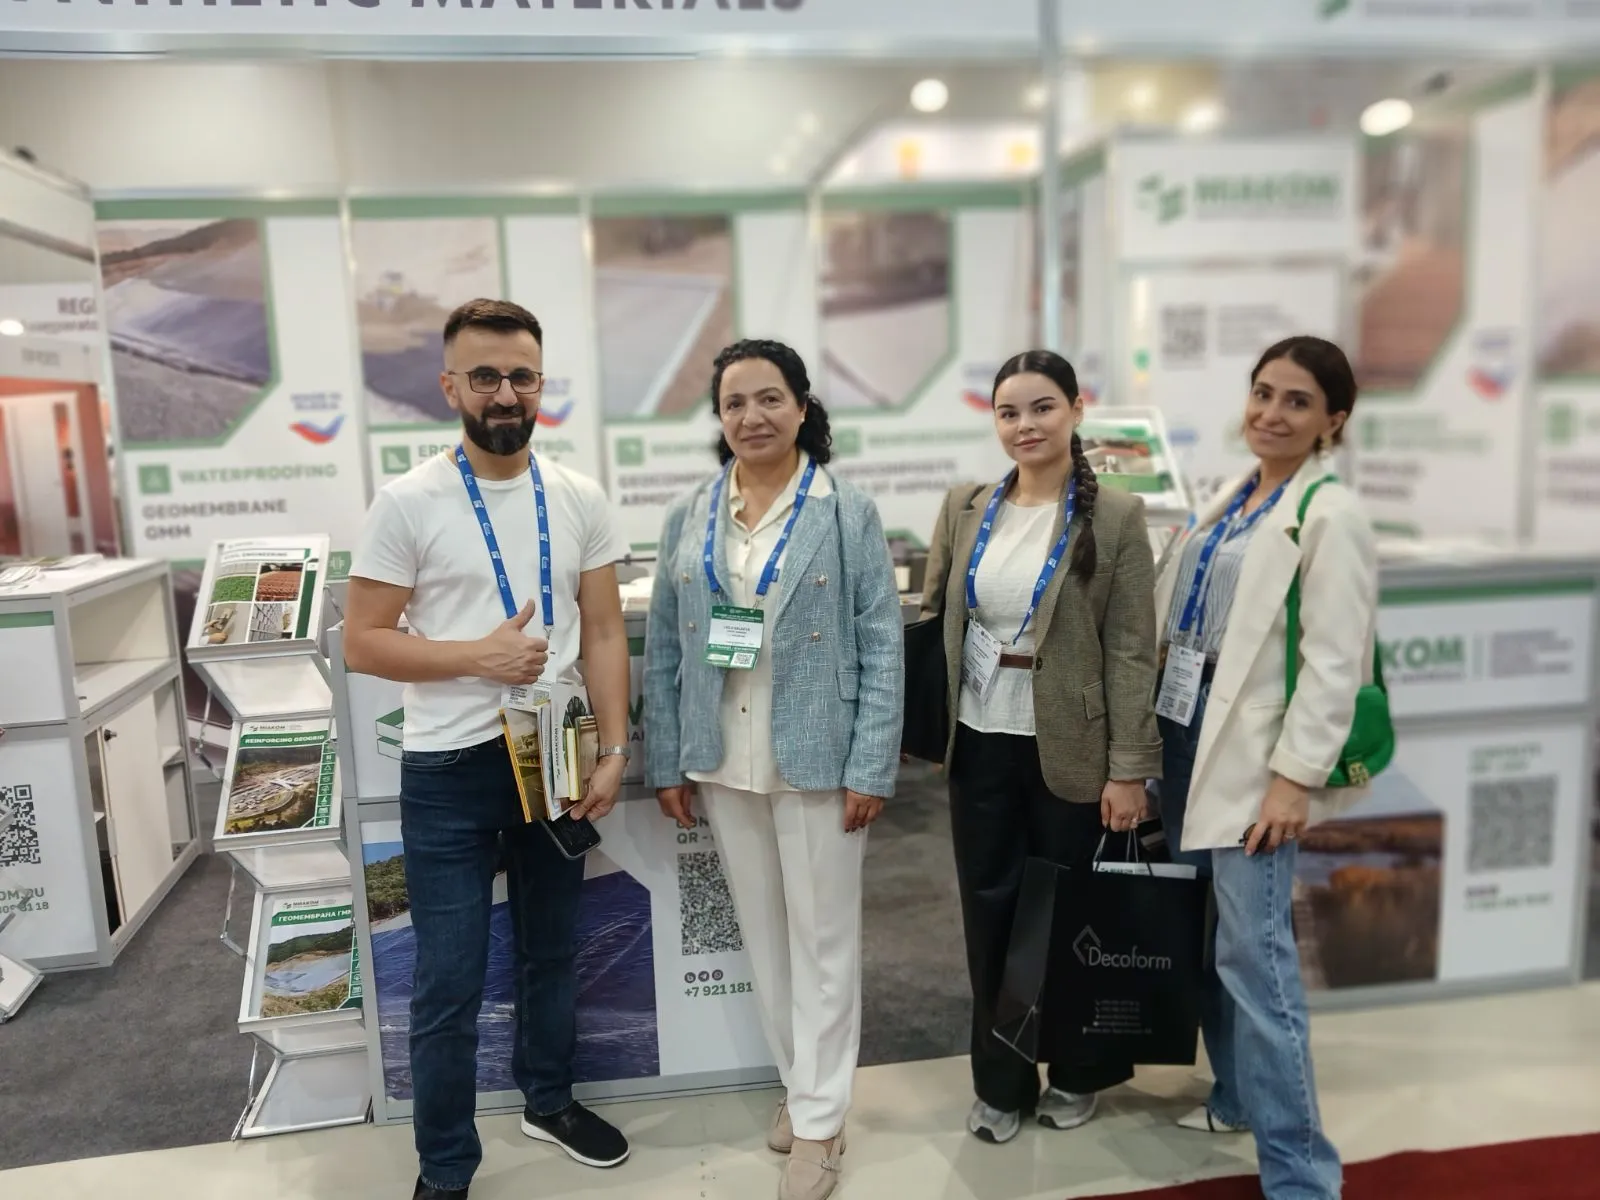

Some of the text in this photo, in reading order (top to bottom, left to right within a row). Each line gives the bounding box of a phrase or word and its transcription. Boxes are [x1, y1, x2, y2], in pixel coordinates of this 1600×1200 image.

[178, 464, 338, 485] WATERPROOFING
[142, 499, 287, 519] GEOMEMBRANE
[145, 525, 191, 541] GMM
[677, 832, 698, 844] QR
[278, 911, 336, 922] ГЕОМЕМБРАНА
[1088, 945, 1171, 970] Decoform
[684, 981, 754, 998] +7 921 181
